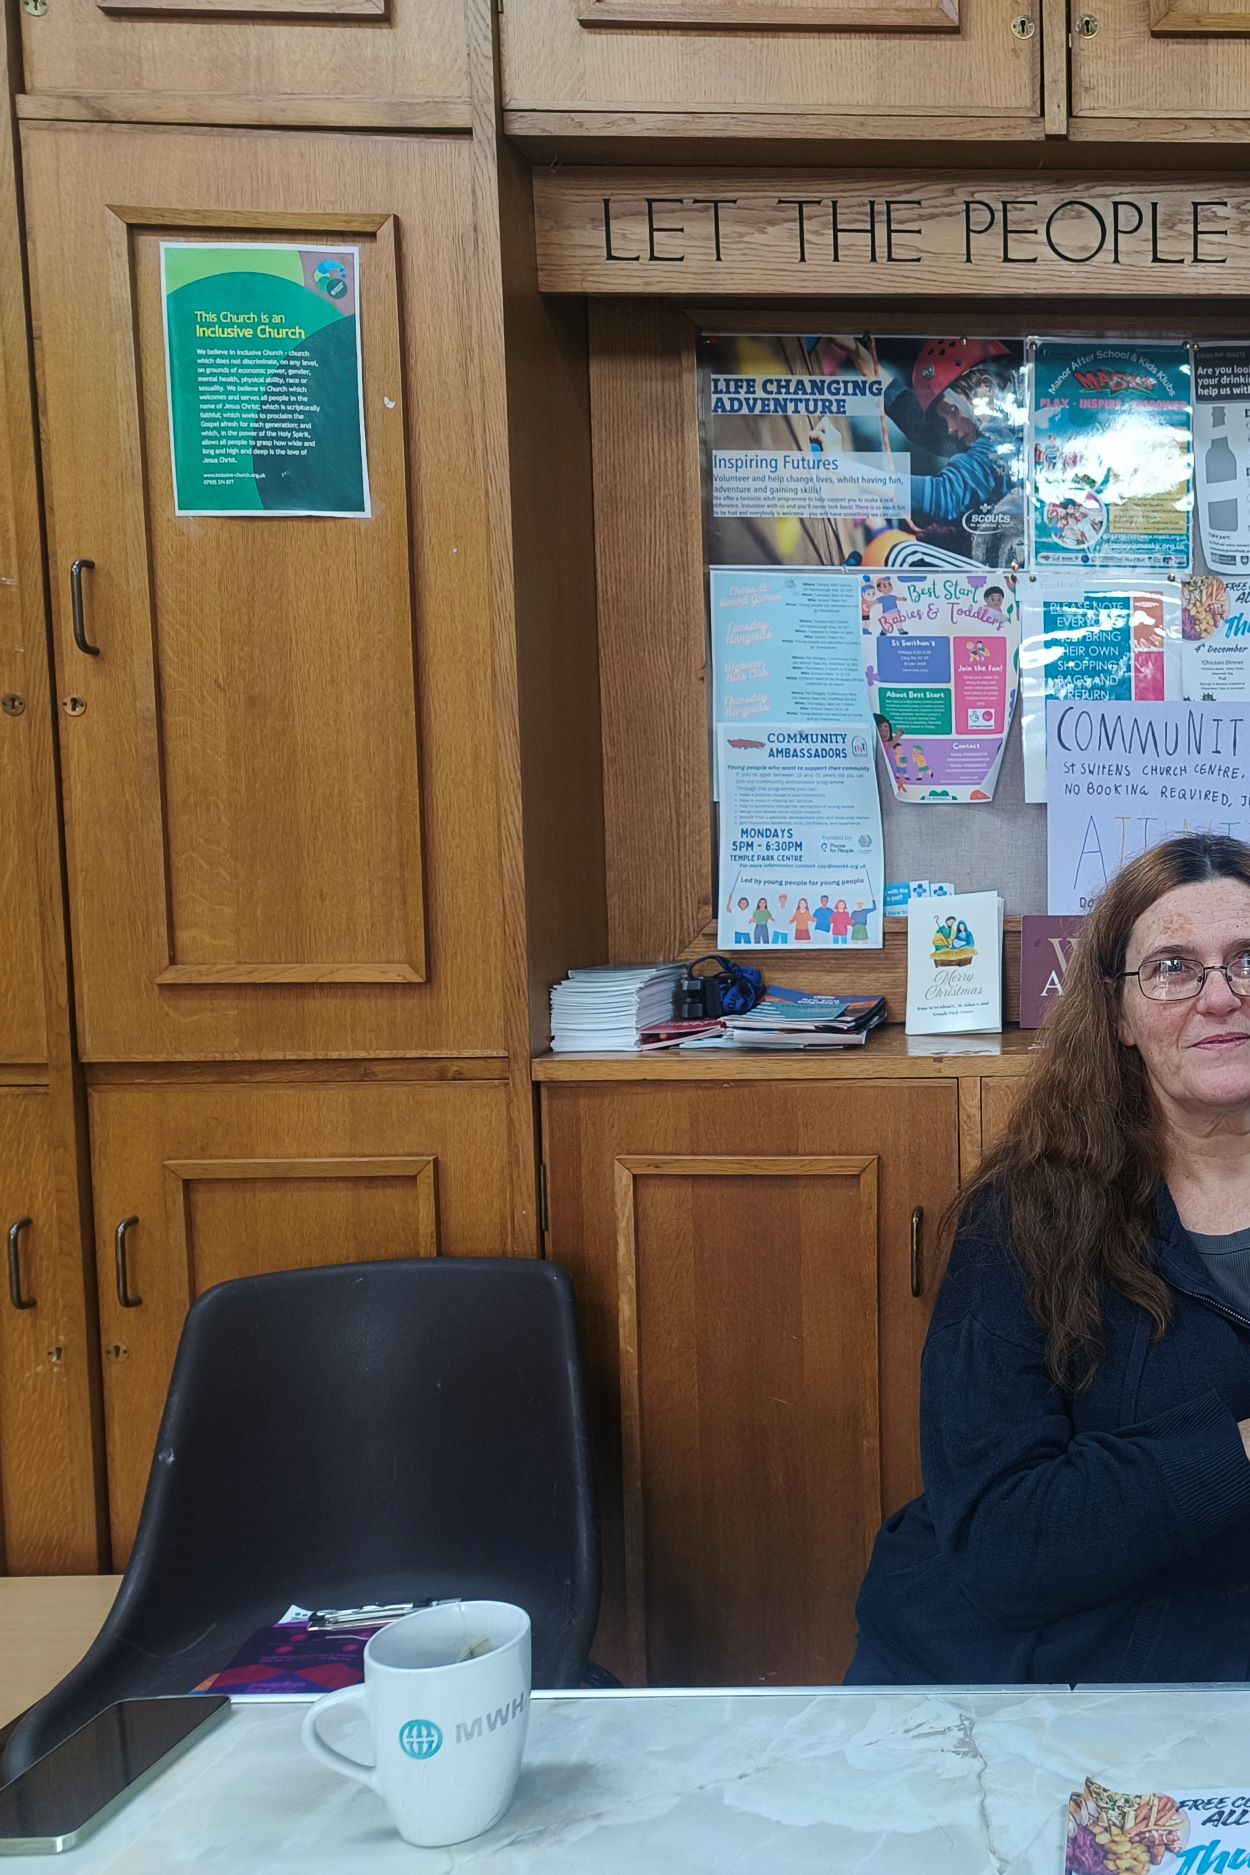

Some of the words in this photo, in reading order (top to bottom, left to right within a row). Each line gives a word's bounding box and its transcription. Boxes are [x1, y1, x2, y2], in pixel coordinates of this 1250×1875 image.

[602, 198, 738, 262] LET
[777, 199, 923, 264] THE
[964, 200, 1228, 264] PEOPLE
[195, 311, 216, 323] This
[220, 311, 257, 323] Church
[261, 312, 269, 323] is
[272, 315, 285, 323] an
[196, 325, 253, 338] Inclusive
[257, 326, 305, 339] Church
[1049, 370, 1071, 395] Manor
[1071, 353, 1094, 371] After
[1096, 350, 1129, 359] School
[1131, 353, 1138, 362] &
[1138, 359, 1158, 376] Kids
[1156, 372, 1176, 397] Klubs
[1198, 366, 1212, 375] Are
[1215, 366, 1231, 376] you
[712, 378, 756, 395] LIFE
[762, 379, 883, 396] CHANGING
[1198, 376, 1218, 387] your
[1198, 386, 1218, 396] help
[712, 397, 846, 414] ADVENTURE
[713, 455, 778, 472] Inspiring
[783, 455, 838, 470] Futures
[971, 513, 1010, 523] scouts
[908, 580, 940, 603] Best
[944, 579, 979, 603] Start
[1224, 582, 1247, 591] FREE
[878, 608, 923, 633] Babies
[927, 603, 939, 620] &
[947, 602, 1004, 630] Toddlers
[767, 733, 847, 744] COMMUNITY
[768, 748, 847, 759] AMBASSADORS
[1142, 765, 1186, 775] CHURCH
[1065, 784, 1080, 795] NO
[1087, 782, 1149, 795] BOOKING
[1160, 786, 1233, 807] REQUIRED,
[741, 828, 793, 839] MONDAYS
[732, 841, 753, 851] 5PM
[765, 841, 802, 852] 6:30PM
[757, 854, 775, 862] PARK
[777, 854, 803, 862] CENTRE
[753, 878, 762, 886] by
[764, 879, 783, 887] young
[785, 879, 807, 887] people
[820, 879, 840, 887] young
[841, 878, 864, 886] people
[934, 970, 973, 987] Merry
[925, 985, 983, 1000] Christmas
[456, 1692, 524, 1744] MWH
[1177, 1795, 1228, 1811] FREE
[1201, 1808, 1250, 1826] ALL
